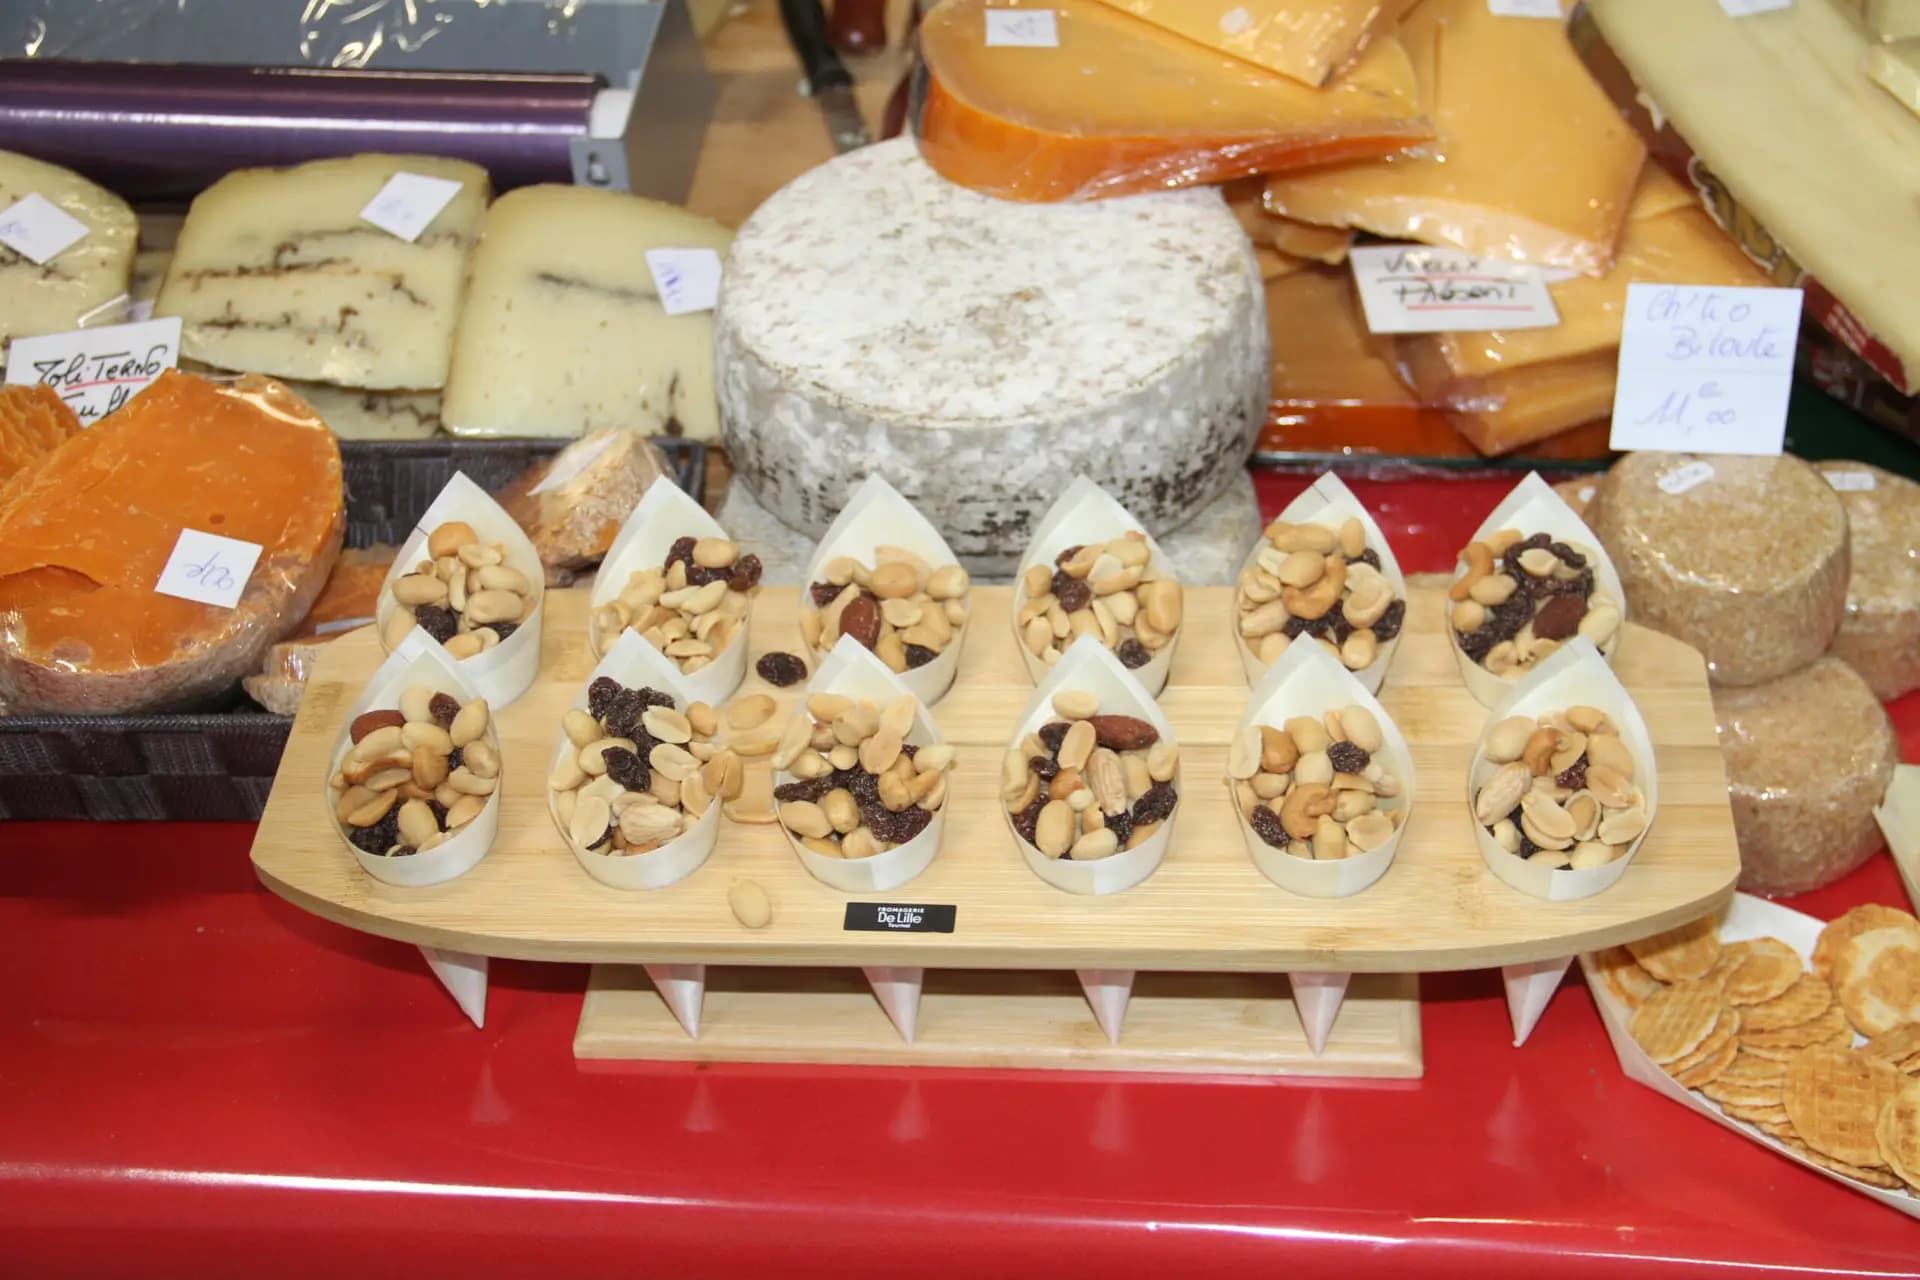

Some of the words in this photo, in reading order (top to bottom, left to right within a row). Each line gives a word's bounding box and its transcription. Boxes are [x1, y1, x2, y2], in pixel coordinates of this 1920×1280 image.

[877, 906, 926, 914] FROMAGERIE
[877, 911, 896, 924] De
[896, 911, 923, 924] Lille
